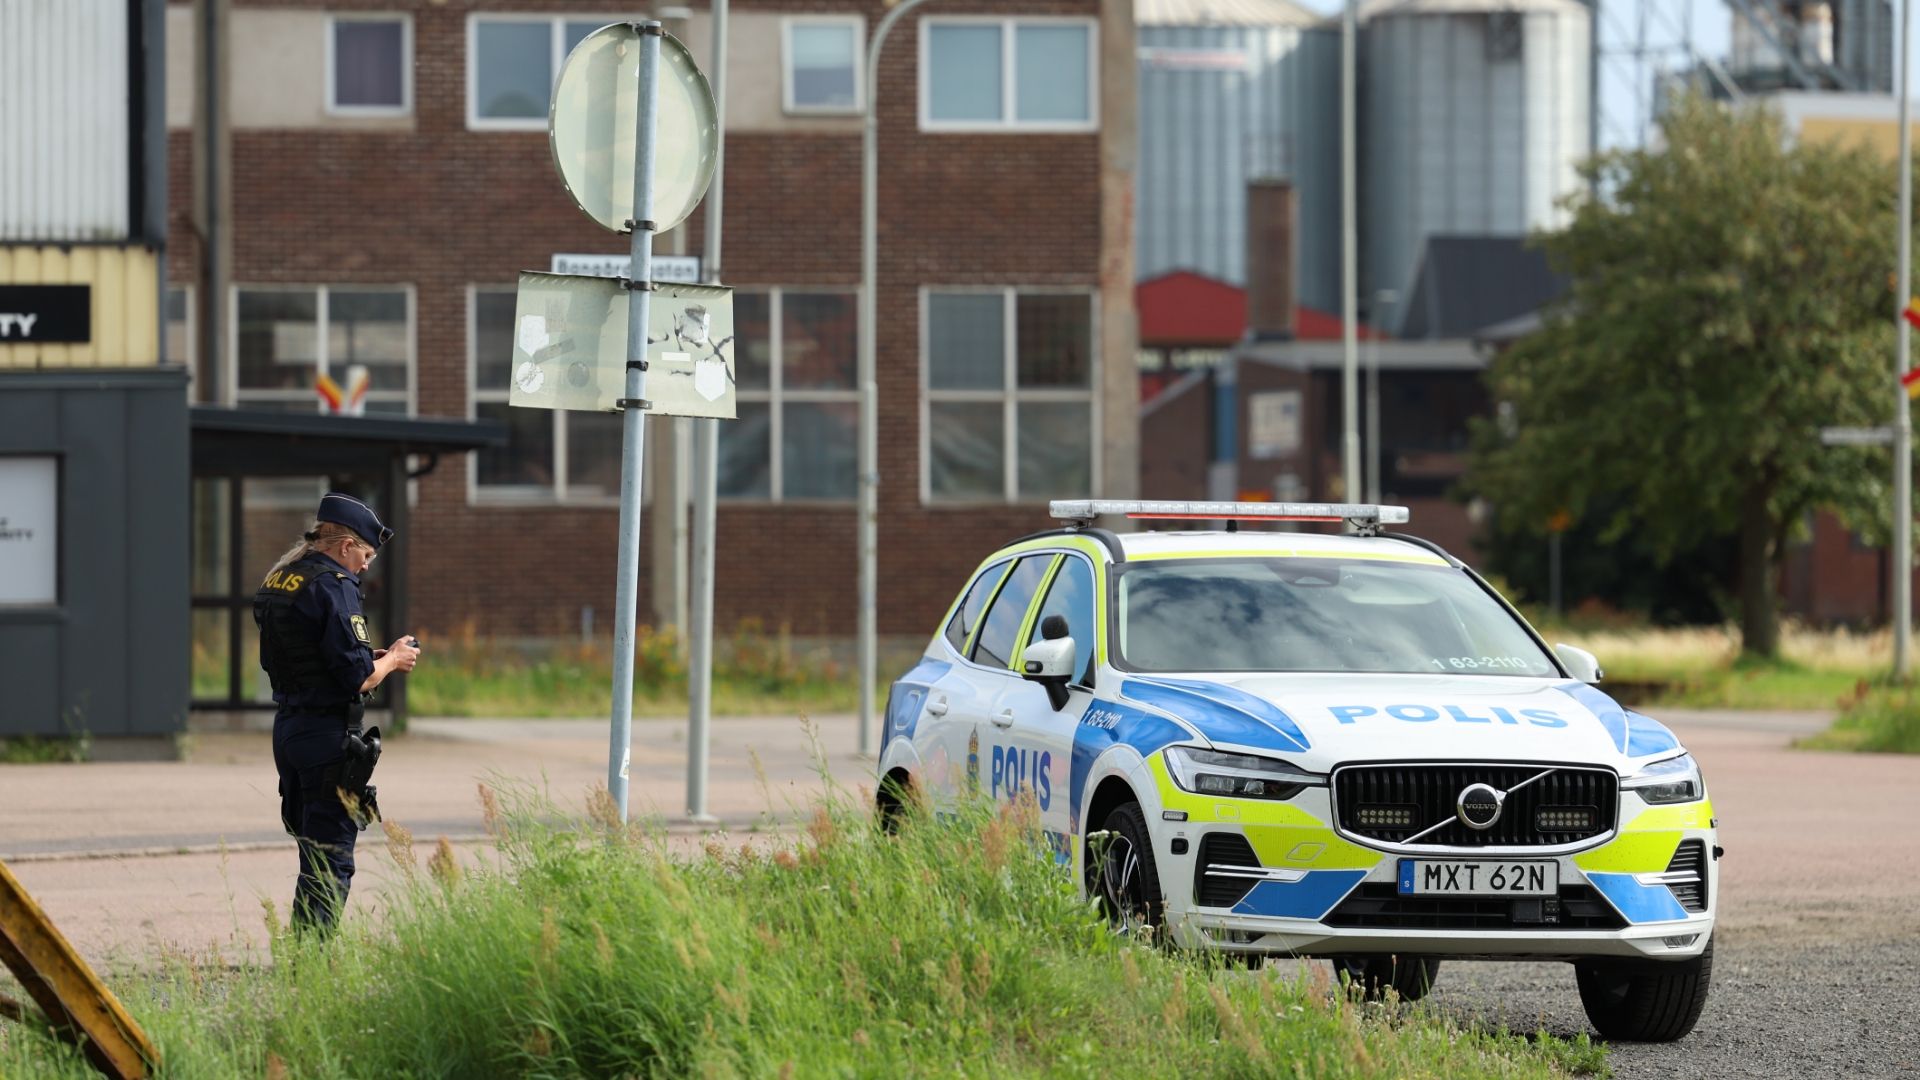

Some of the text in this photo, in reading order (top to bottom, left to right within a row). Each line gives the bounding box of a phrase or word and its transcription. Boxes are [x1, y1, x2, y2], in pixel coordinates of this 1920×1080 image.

[0, 312, 38, 337] TY
[265, 570, 304, 592] OLIS
[1449, 656, 1527, 669] 63-2110
[1327, 704, 1569, 728] POLIS
[1424, 864, 1545, 891] MXT 62N
